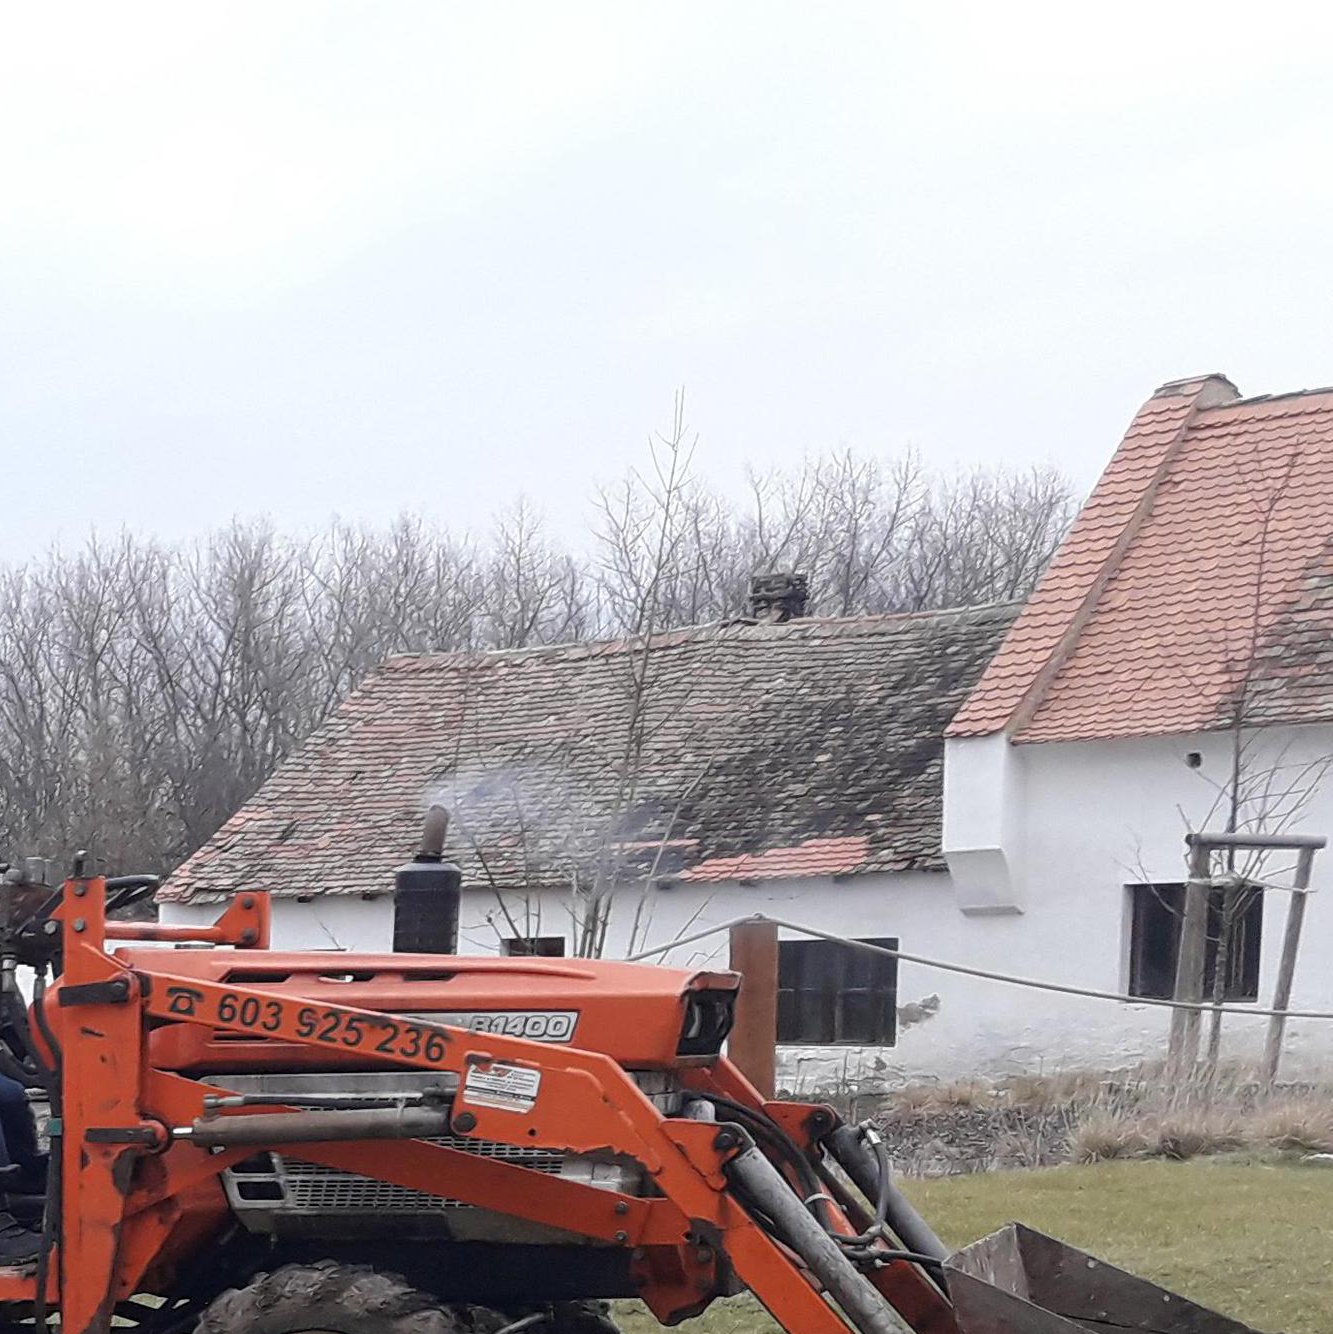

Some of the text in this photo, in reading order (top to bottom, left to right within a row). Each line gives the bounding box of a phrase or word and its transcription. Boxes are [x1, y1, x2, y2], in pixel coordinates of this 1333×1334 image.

[217, 993, 447, 1062] 603 925 236
